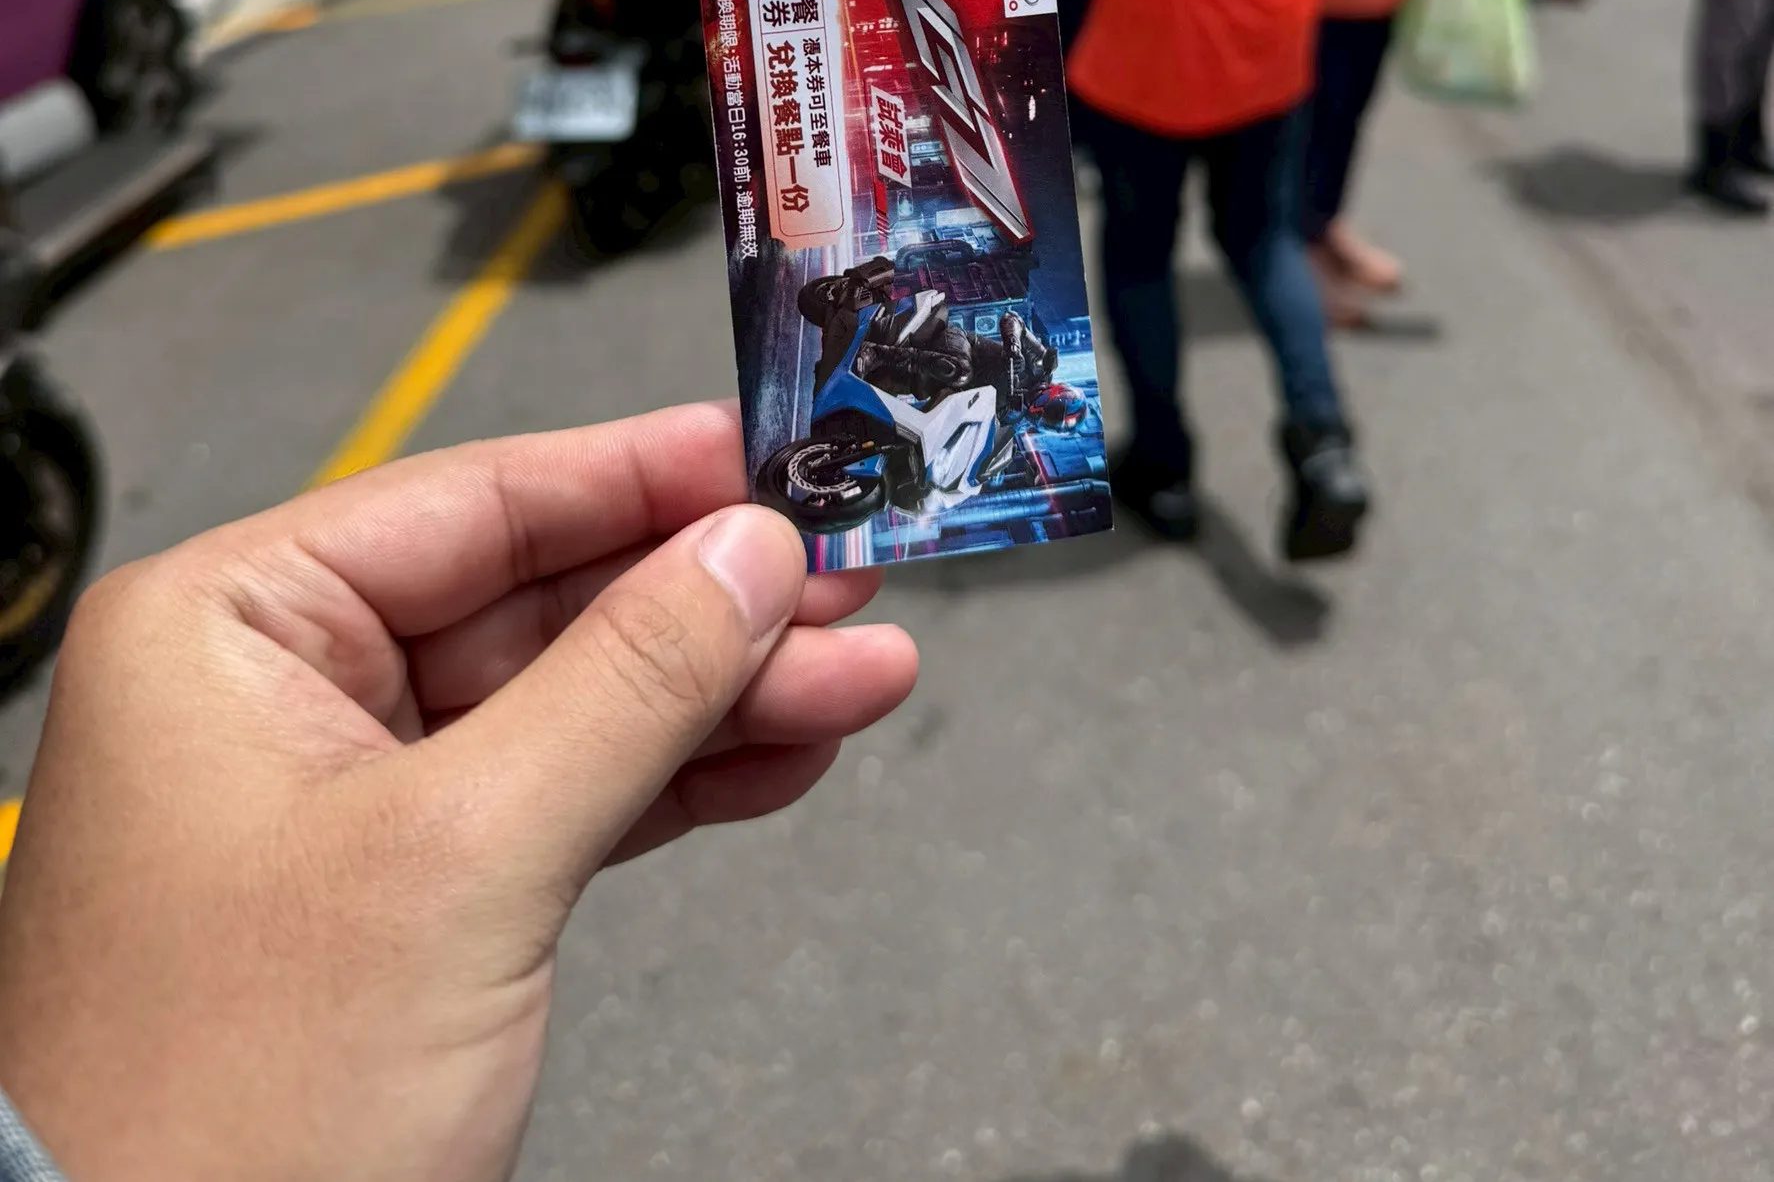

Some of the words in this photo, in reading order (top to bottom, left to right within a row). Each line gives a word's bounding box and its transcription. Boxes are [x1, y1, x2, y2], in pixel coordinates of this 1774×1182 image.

[766, 40, 810, 213] 兌換餐點一份
[802, 37, 832, 168] 憑本券可至餐車
[876, 95, 909, 179] 試乘會
